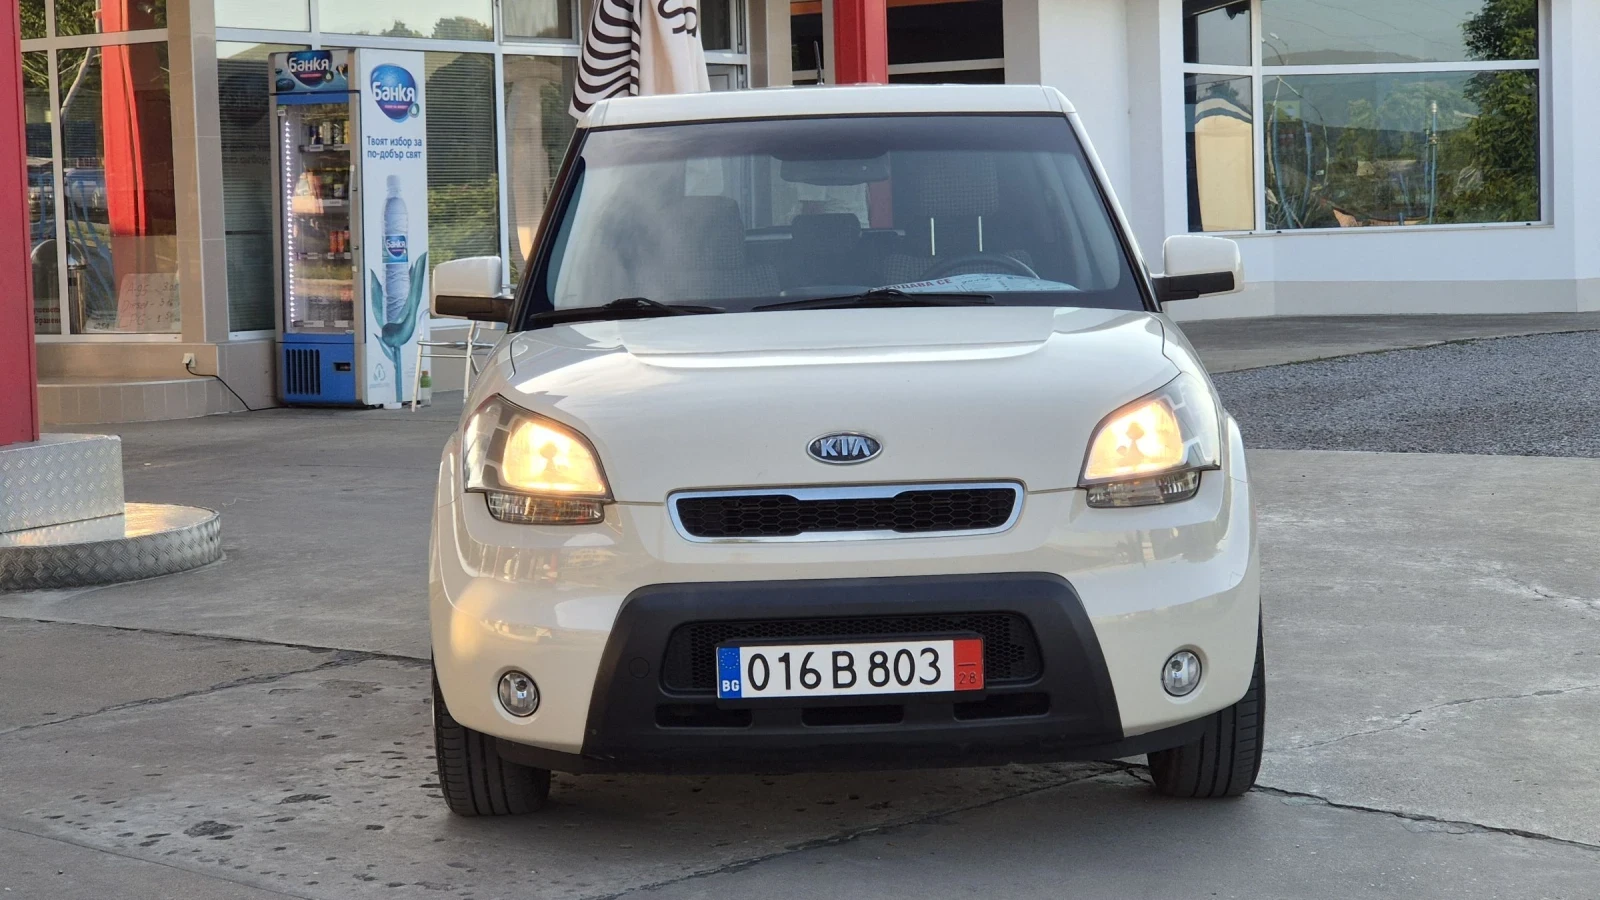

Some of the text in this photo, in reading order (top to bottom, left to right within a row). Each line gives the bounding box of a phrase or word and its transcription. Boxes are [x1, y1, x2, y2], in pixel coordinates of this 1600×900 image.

[366, 136, 422, 149] Твоят избор за
[367, 149, 421, 160] по-добър свят
[820, 435, 871, 457] KIA
[722, 679, 740, 692] BG
[958, 672, 977, 685] 28
